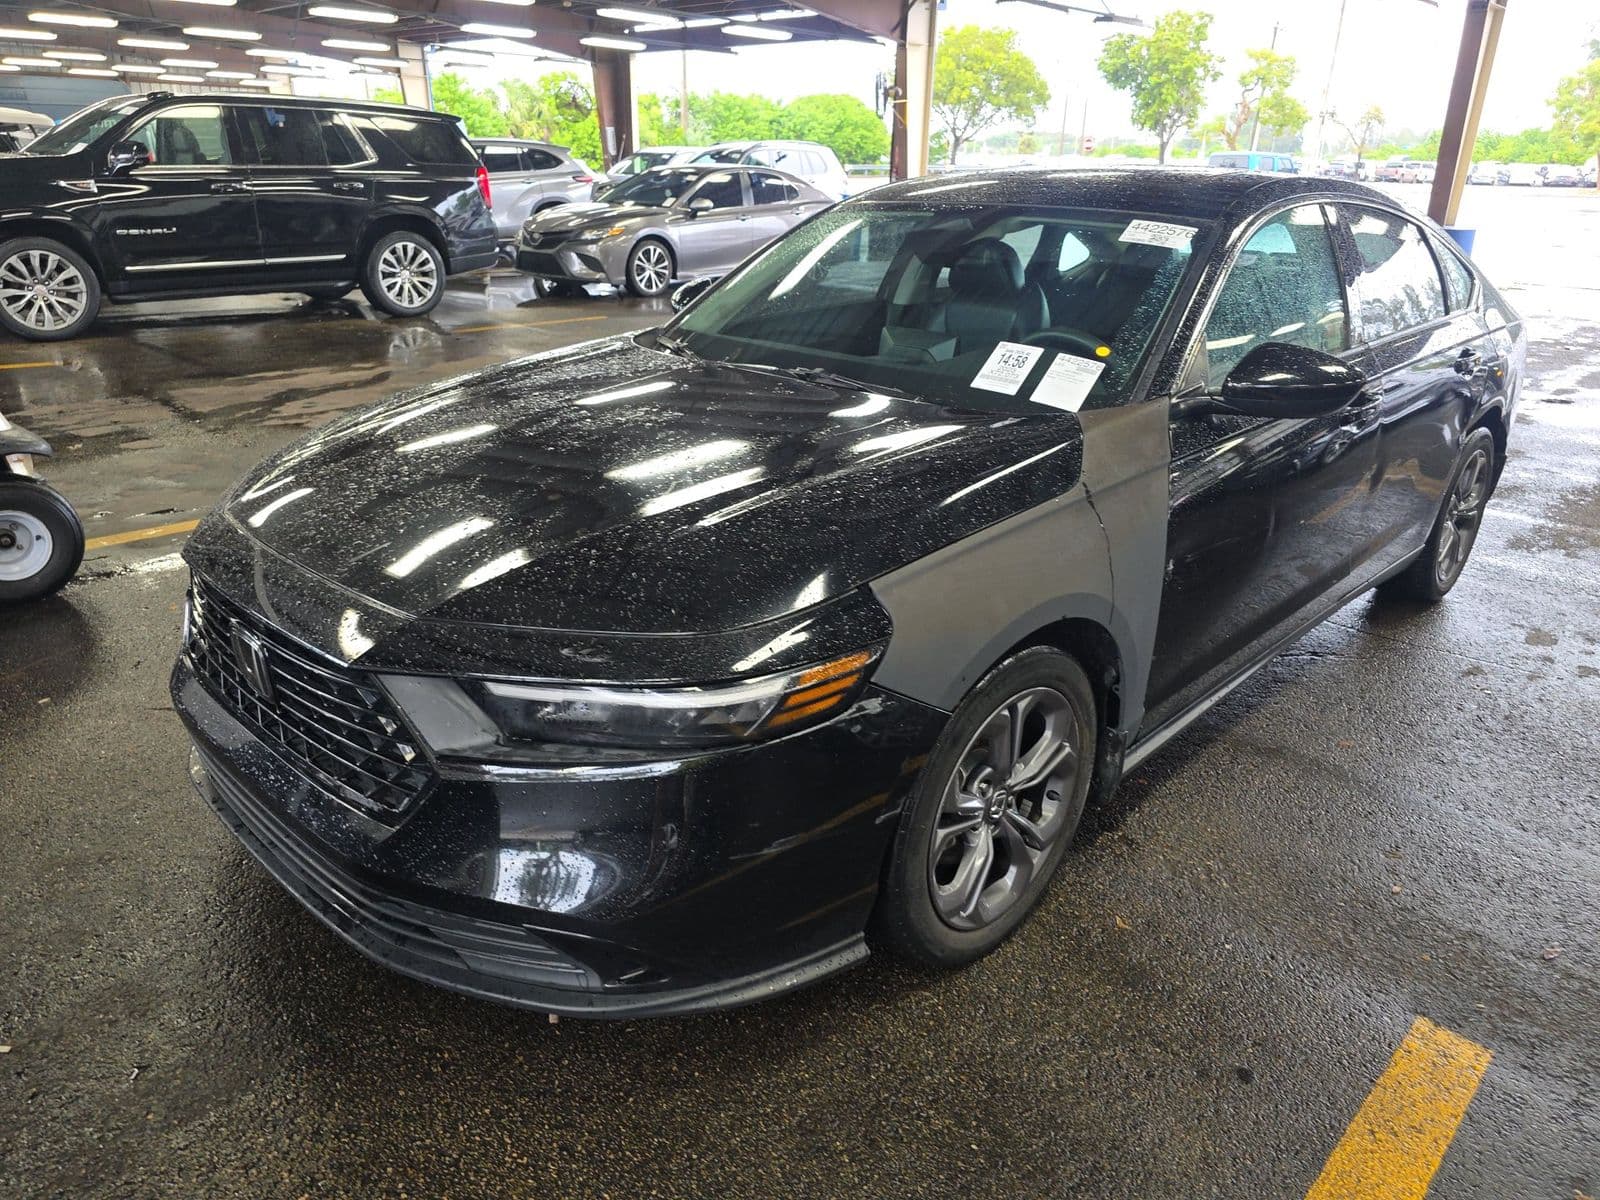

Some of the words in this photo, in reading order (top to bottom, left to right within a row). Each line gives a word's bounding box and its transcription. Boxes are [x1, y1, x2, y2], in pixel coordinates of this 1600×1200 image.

[116, 227, 177, 235] DENALI
[1131, 223, 1195, 239] 4422576
[998, 354, 1028, 369] 14:58
